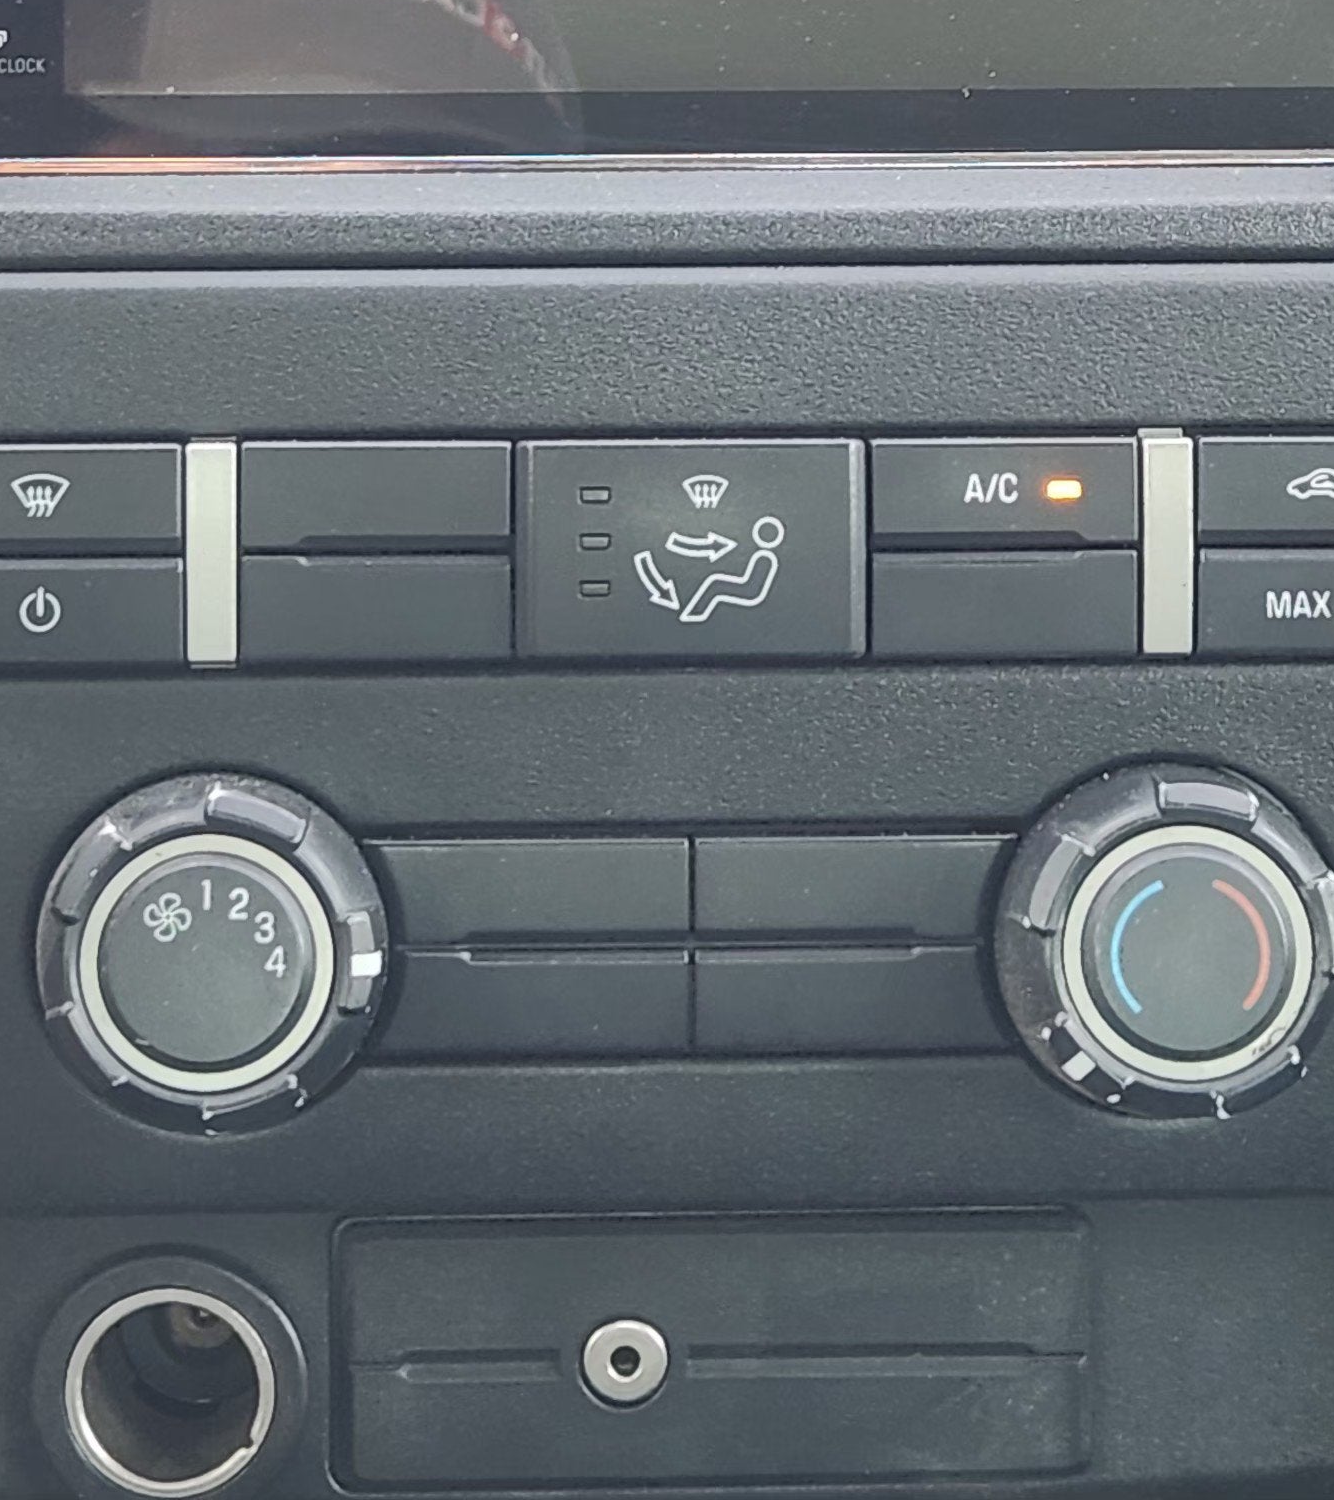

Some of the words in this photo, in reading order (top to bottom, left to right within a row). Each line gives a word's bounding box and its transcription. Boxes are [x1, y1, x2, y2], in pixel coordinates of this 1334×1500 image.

[963, 472, 1019, 504] A/C
[1266, 590, 1332, 620] MAX
[200, 879, 212, 911] 1
[228, 887, 250, 921] 2
[254, 911, 276, 944] 3
[264, 945, 287, 979] 4
